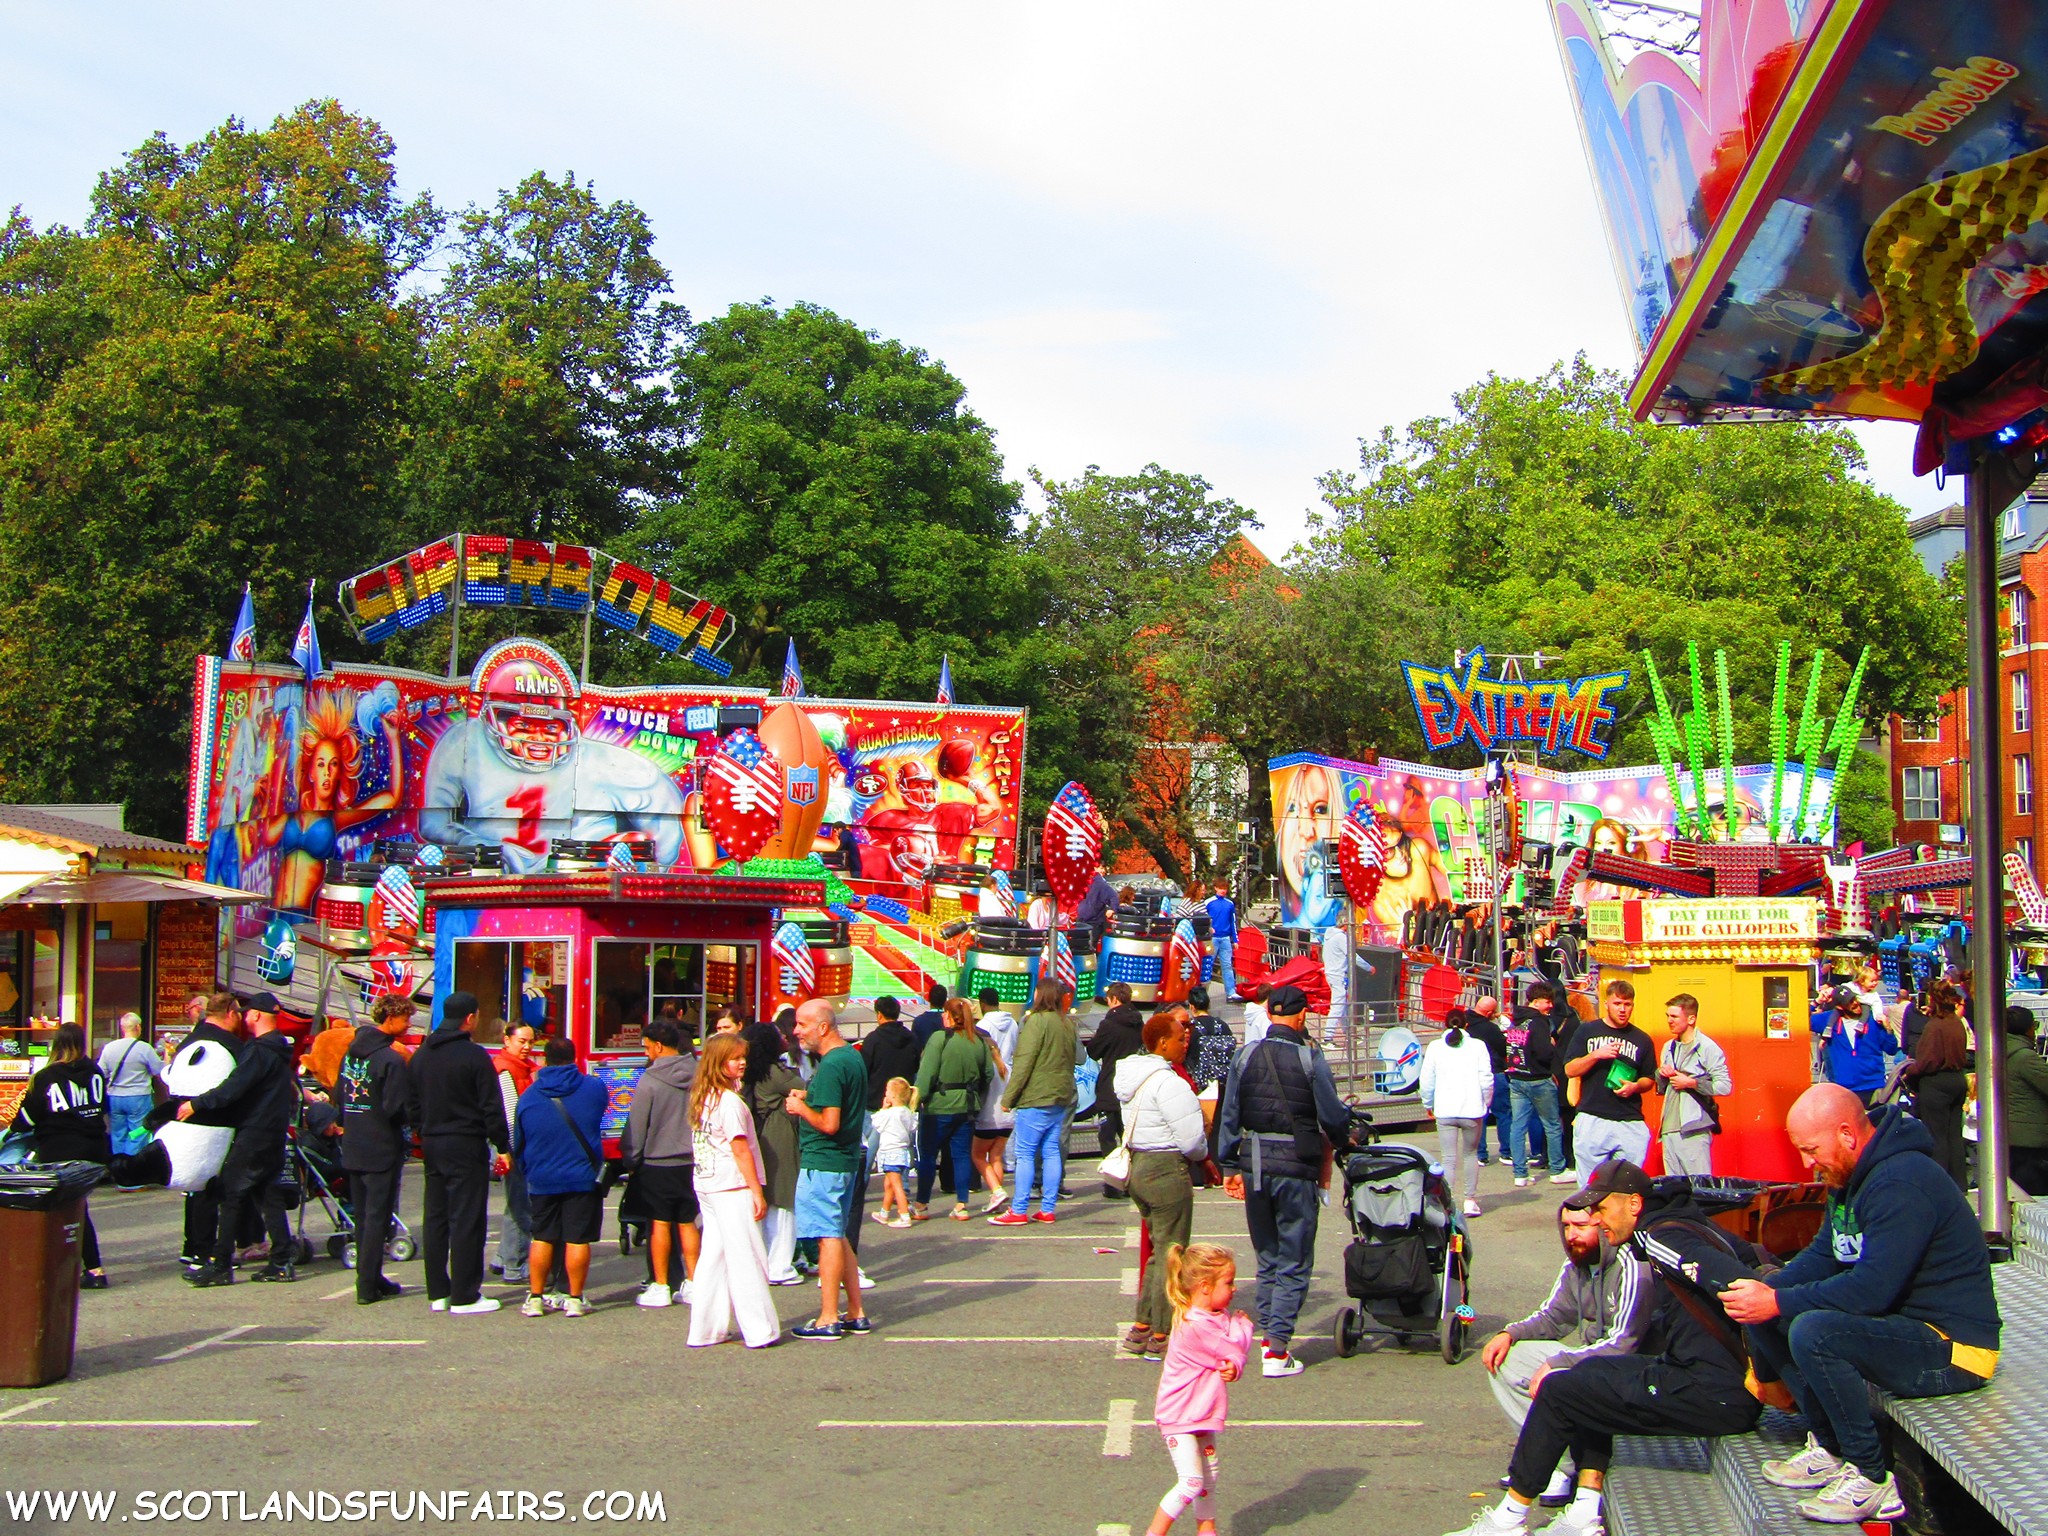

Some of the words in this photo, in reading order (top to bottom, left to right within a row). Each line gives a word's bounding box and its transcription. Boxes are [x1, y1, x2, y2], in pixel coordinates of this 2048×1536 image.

[1868, 56, 2020, 147] Porsche
[514, 675, 559, 695] RAMS
[406, 693, 462, 723] USA
[1400, 645, 1631, 761] EXTREME
[601, 704, 670, 733] TOUCH
[214, 689, 237, 783] REDSKINS
[637, 730, 699, 760] DOWN
[857, 724, 942, 753] QUARTERBACK
[989, 730, 1012, 797] GIANTS
[791, 782, 816, 801] NFL
[497, 785, 548, 854] 1
[336, 834, 361, 855] The
[1669, 909, 1699, 922] PAY
[1706, 908, 1751, 921] HERE
[1757, 907, 1791, 920] FOR
[161, 923, 180, 933] Chips
[189, 923, 213, 933] Cheese
[1661, 924, 1696, 937] THE
[1701, 922, 1799, 936] GALLOPERS
[160, 940, 180, 951] Chips
[188, 941, 208, 951] Curry
[160, 957, 176, 966] Pork
[187, 957, 206, 968] Chips
[159, 974, 186, 983] Chicken
[187, 974, 209, 984] Strips
[160, 986, 165, 996] &
[166, 986, 186, 997] Chips
[158, 1003, 184, 1014] Loaded
